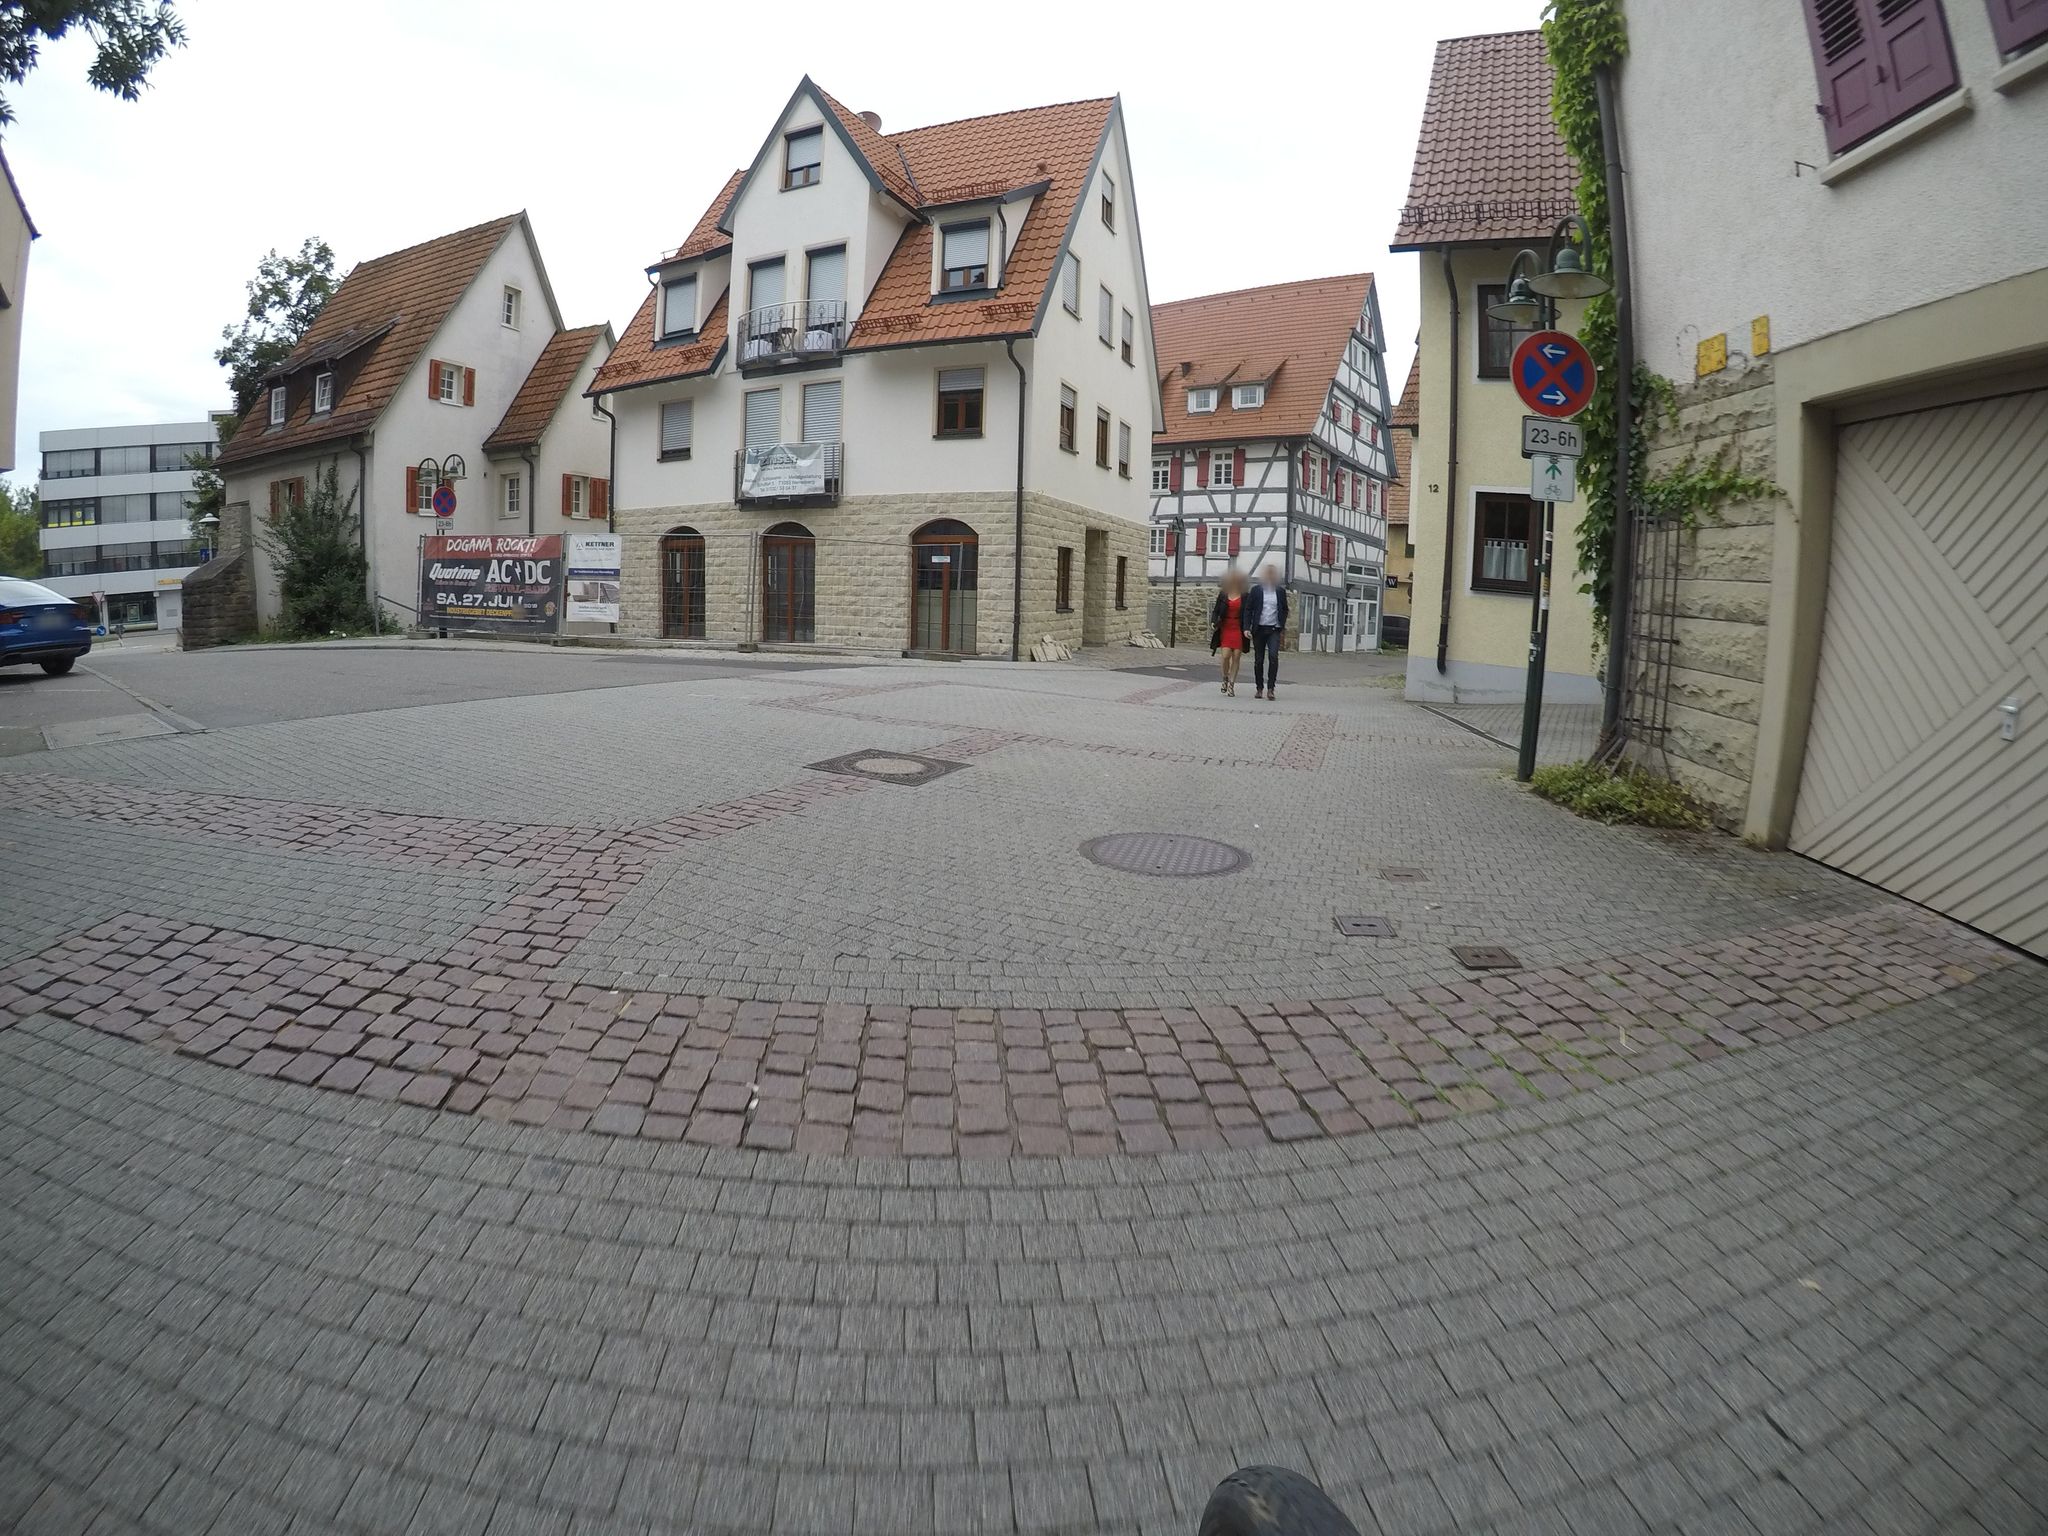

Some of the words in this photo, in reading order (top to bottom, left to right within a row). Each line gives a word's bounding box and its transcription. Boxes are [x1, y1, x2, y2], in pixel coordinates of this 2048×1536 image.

[1530, 427, 1577, 448] 23-6h
[1428, 483, 1439, 493] 12
[447, 538, 493, 553] DOGANA
[496, 538, 537, 553] ROCKT!
[1387, 578, 1397, 587] W
